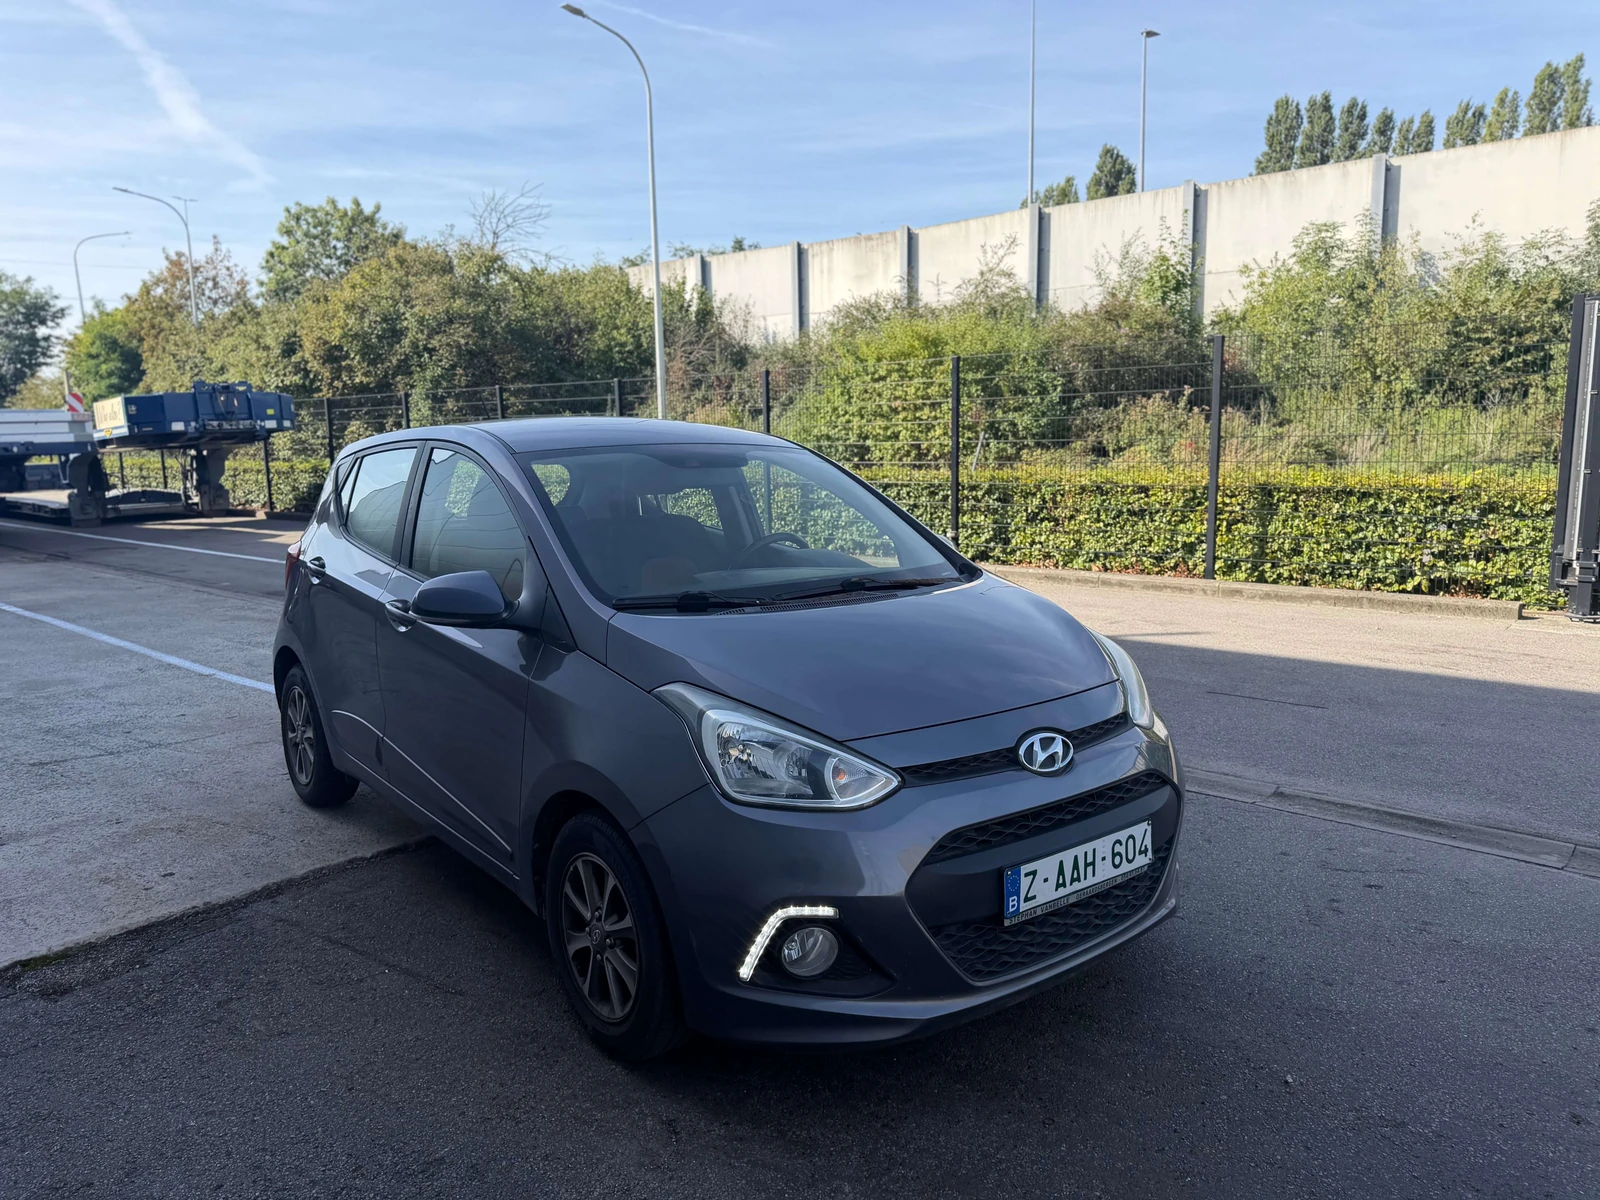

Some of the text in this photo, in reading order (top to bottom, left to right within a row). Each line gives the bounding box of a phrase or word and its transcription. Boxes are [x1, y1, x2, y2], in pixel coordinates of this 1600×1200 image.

[1023, 828, 1149, 904] Z-AAH-604
[1009, 895, 1018, 912] B
[1009, 909, 1038, 924] STEPHAN
